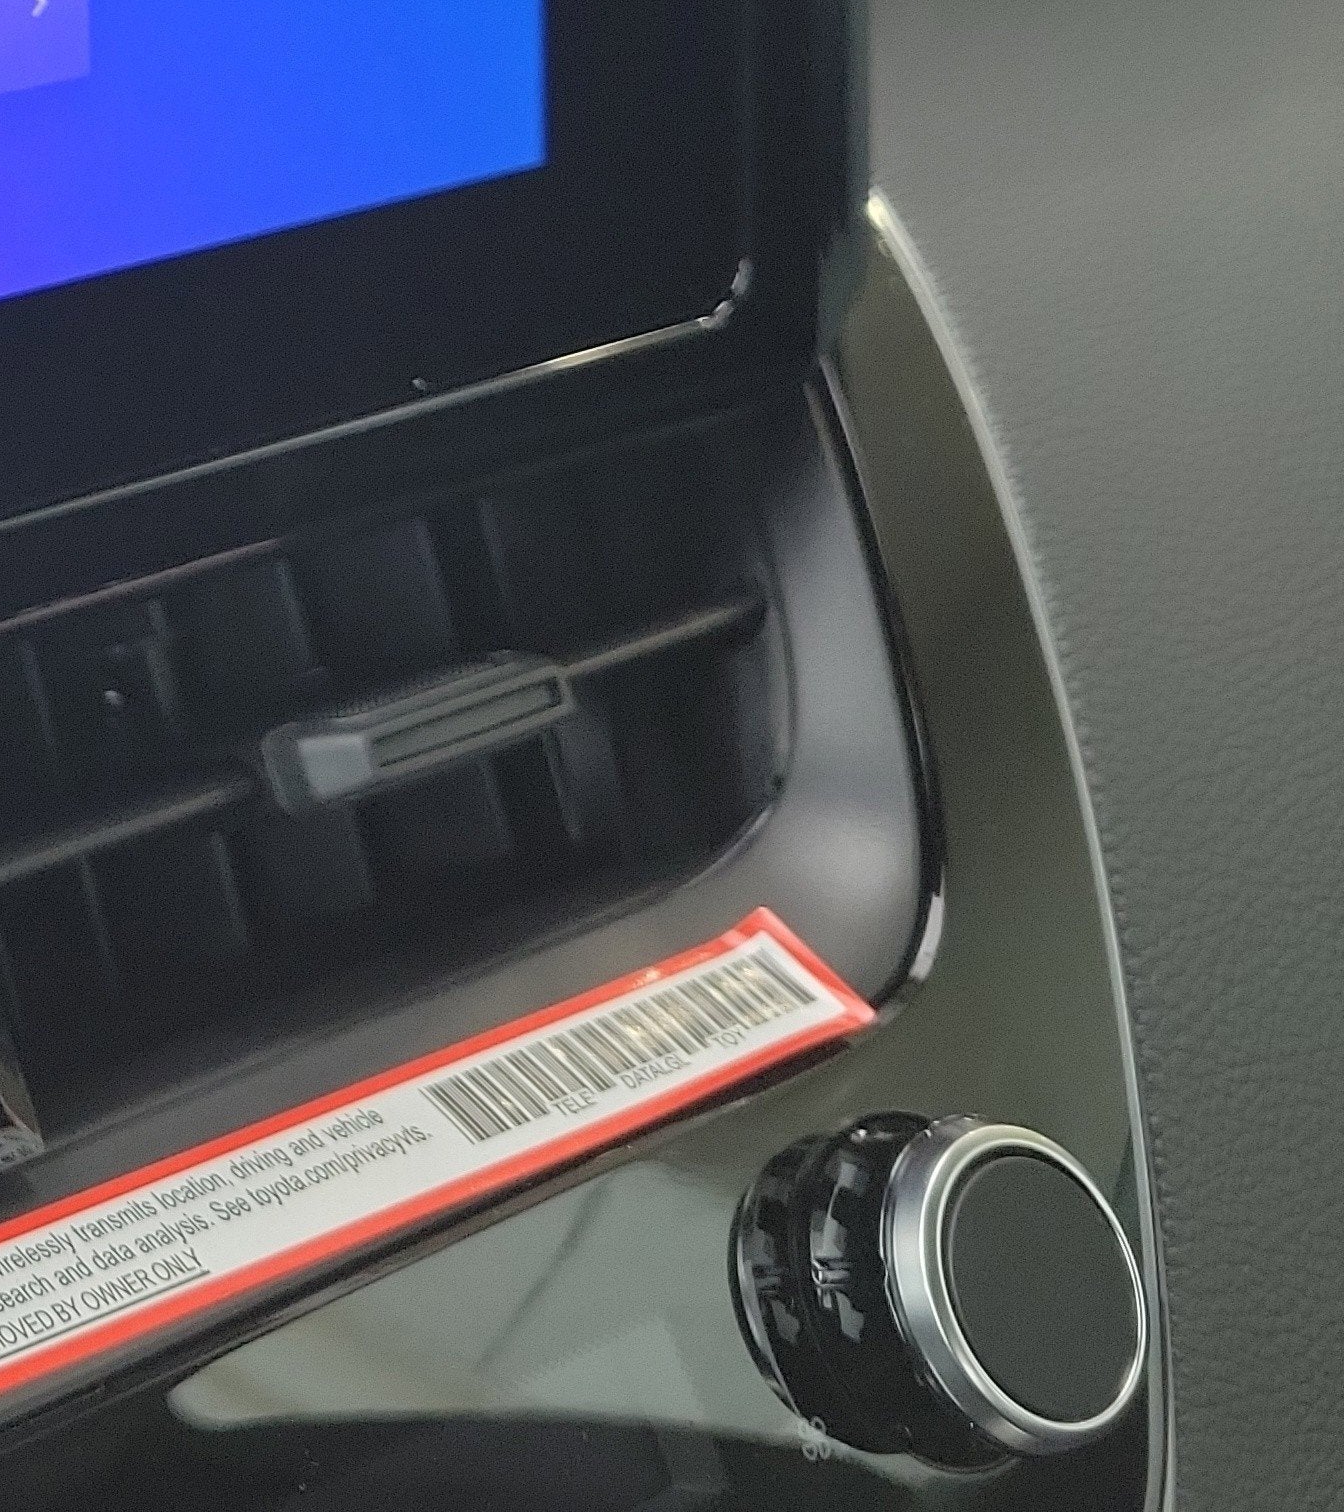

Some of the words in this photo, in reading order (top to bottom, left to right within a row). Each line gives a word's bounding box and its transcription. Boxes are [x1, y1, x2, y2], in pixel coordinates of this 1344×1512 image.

[551, 1088, 599, 1117] TELE
[69, 1196, 159, 1239] transmits
[150, 1163, 234, 1210] location,
[229, 1144, 294, 1181] driving
[288, 1127, 326, 1156] and
[320, 1107, 385, 1141] vehicle
[53, 1253, 93, 1285] and
[90, 1237, 137, 1271] data
[134, 1212, 217, 1254] analysis.
[208, 1196, 253, 1222] See
[51, 1295, 84, 1325] BY
[78, 1264, 158, 1311] OWNER
[150, 1245, 205, 1283] ONLY
